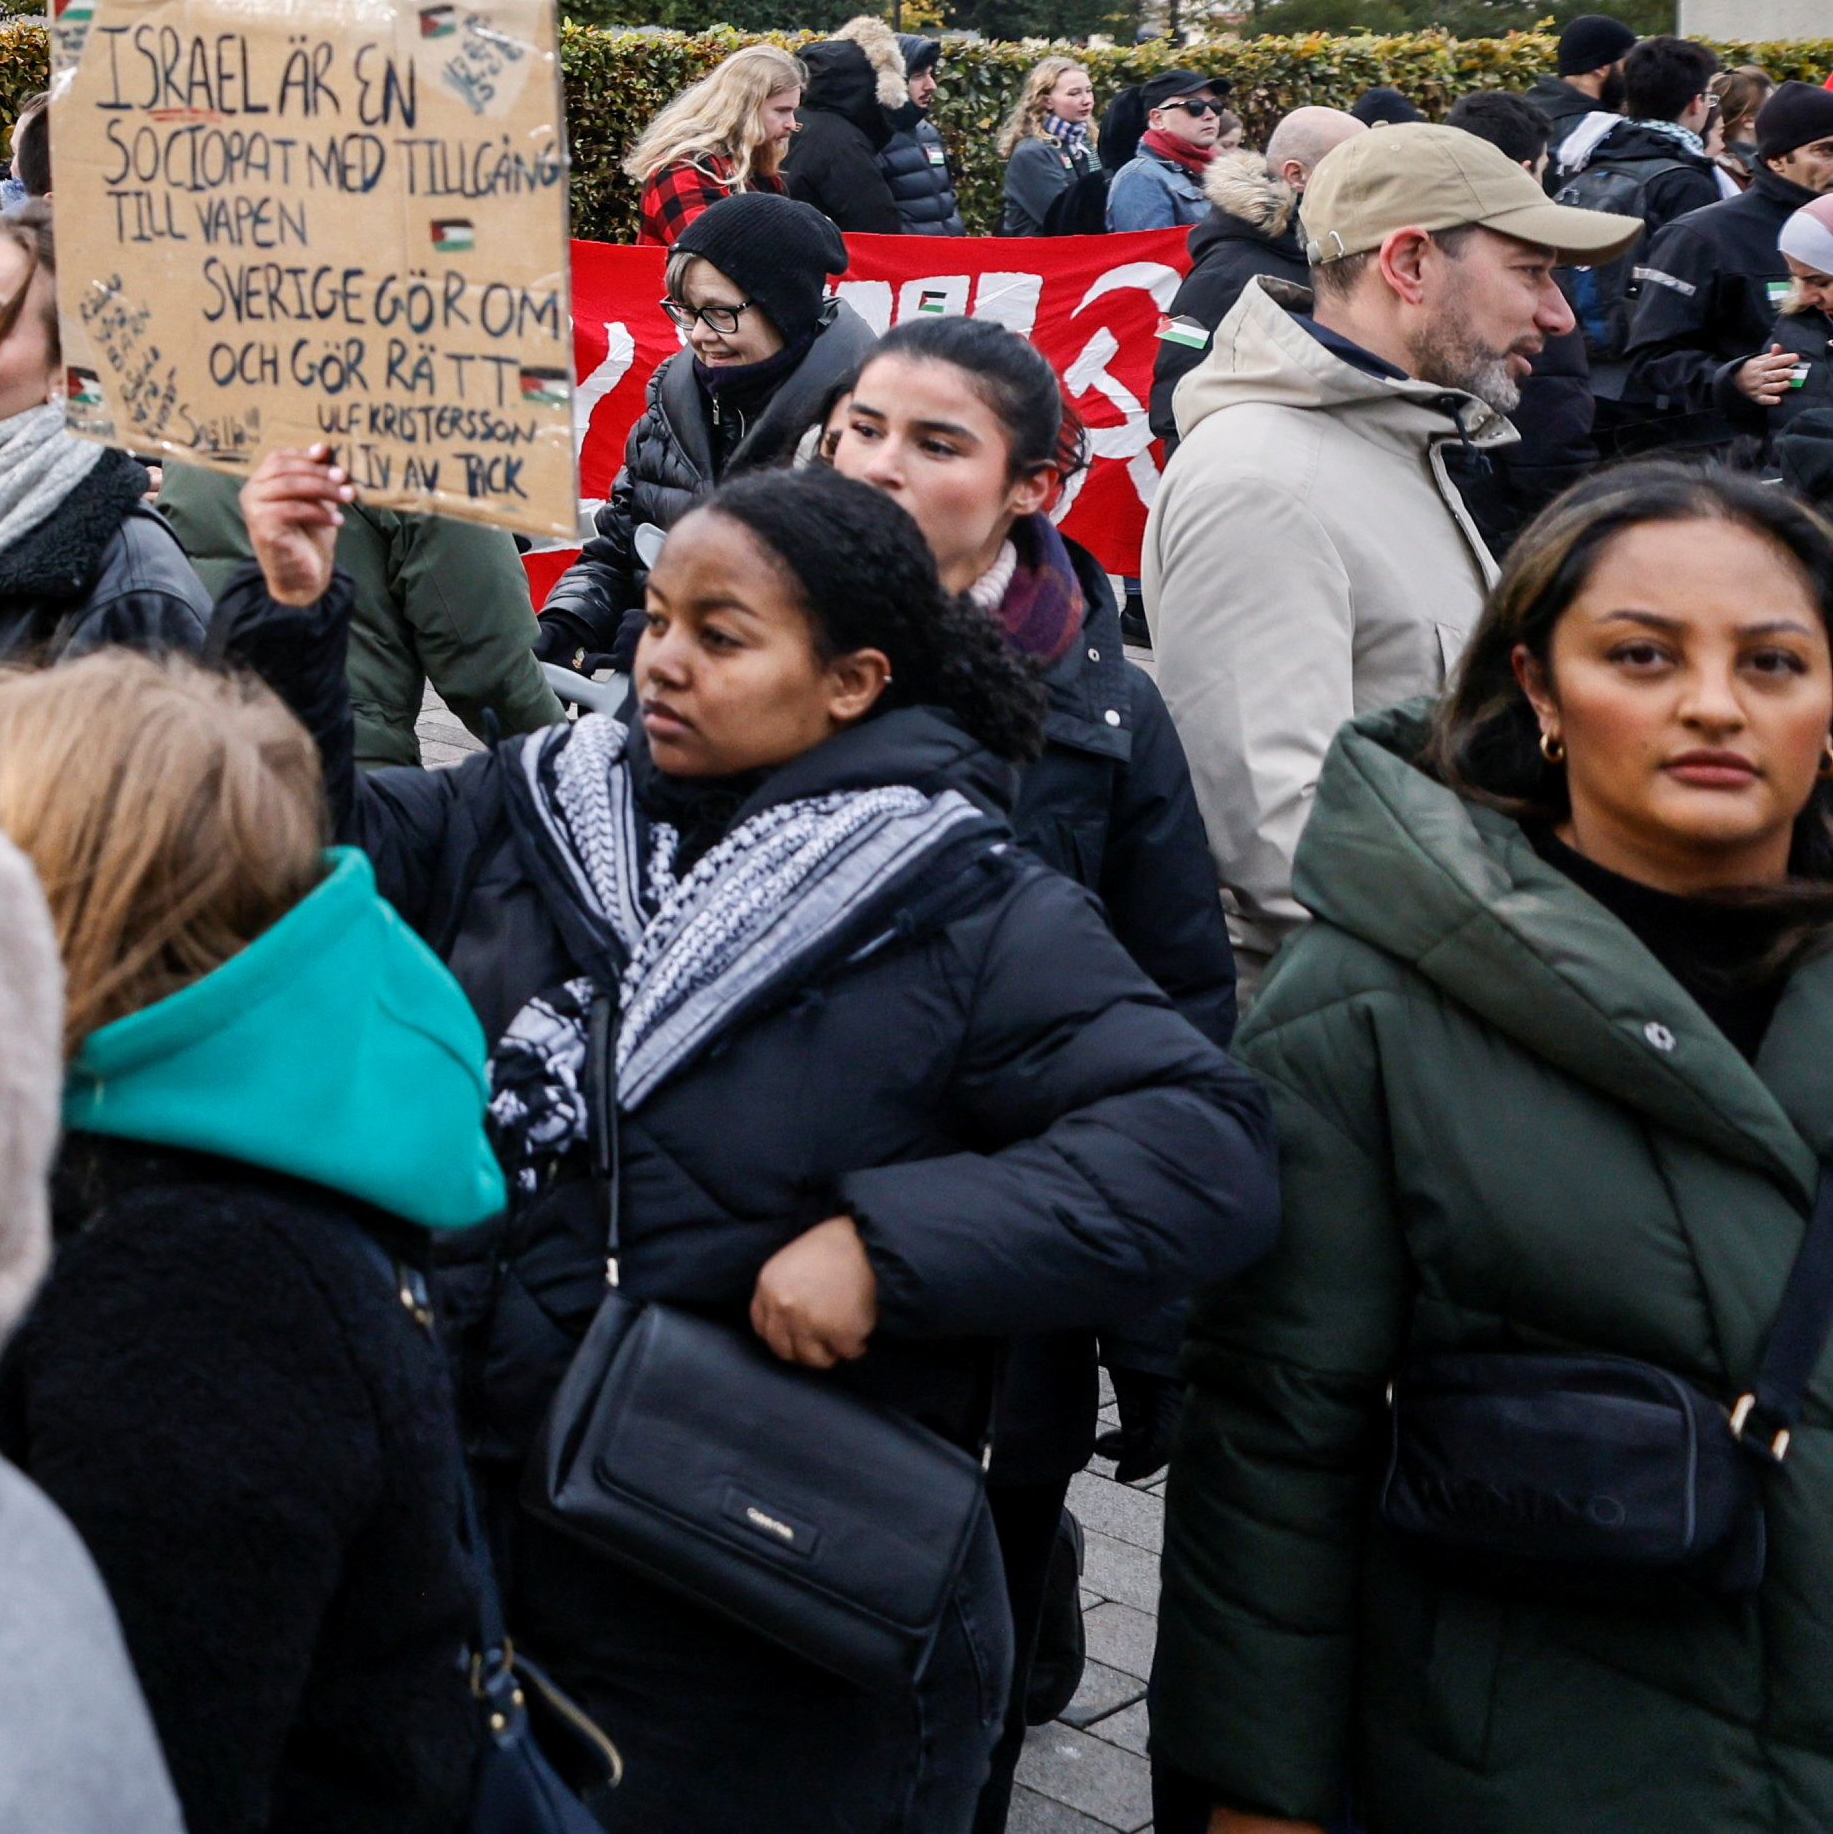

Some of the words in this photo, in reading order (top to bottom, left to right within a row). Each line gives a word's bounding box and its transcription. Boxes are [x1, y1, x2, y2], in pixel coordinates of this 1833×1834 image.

[96, 25, 269, 114] ISRAEL
[279, 35, 340, 117] ÄR
[355, 43, 416, 129] EN
[103, 119, 297, 191] SOCIOPAT
[307, 133, 386, 193] MED
[393, 134, 561, 198] TILLGÅNG
[106, 191, 187, 244] TILL
[196, 196, 308, 248] VAPEN
[203, 257, 366, 324] SVERIGE
[374, 269, 471, 334] GÖR
[481, 283, 560, 340] OM
[209, 341, 279, 386] OCH
[291, 338, 369, 394] GÖR
[386, 339, 520, 407] RÄTT
[318, 403, 362, 433] ULF
[369, 403, 537, 445] KRISTERSSON
[403, 457, 439, 492] AV
